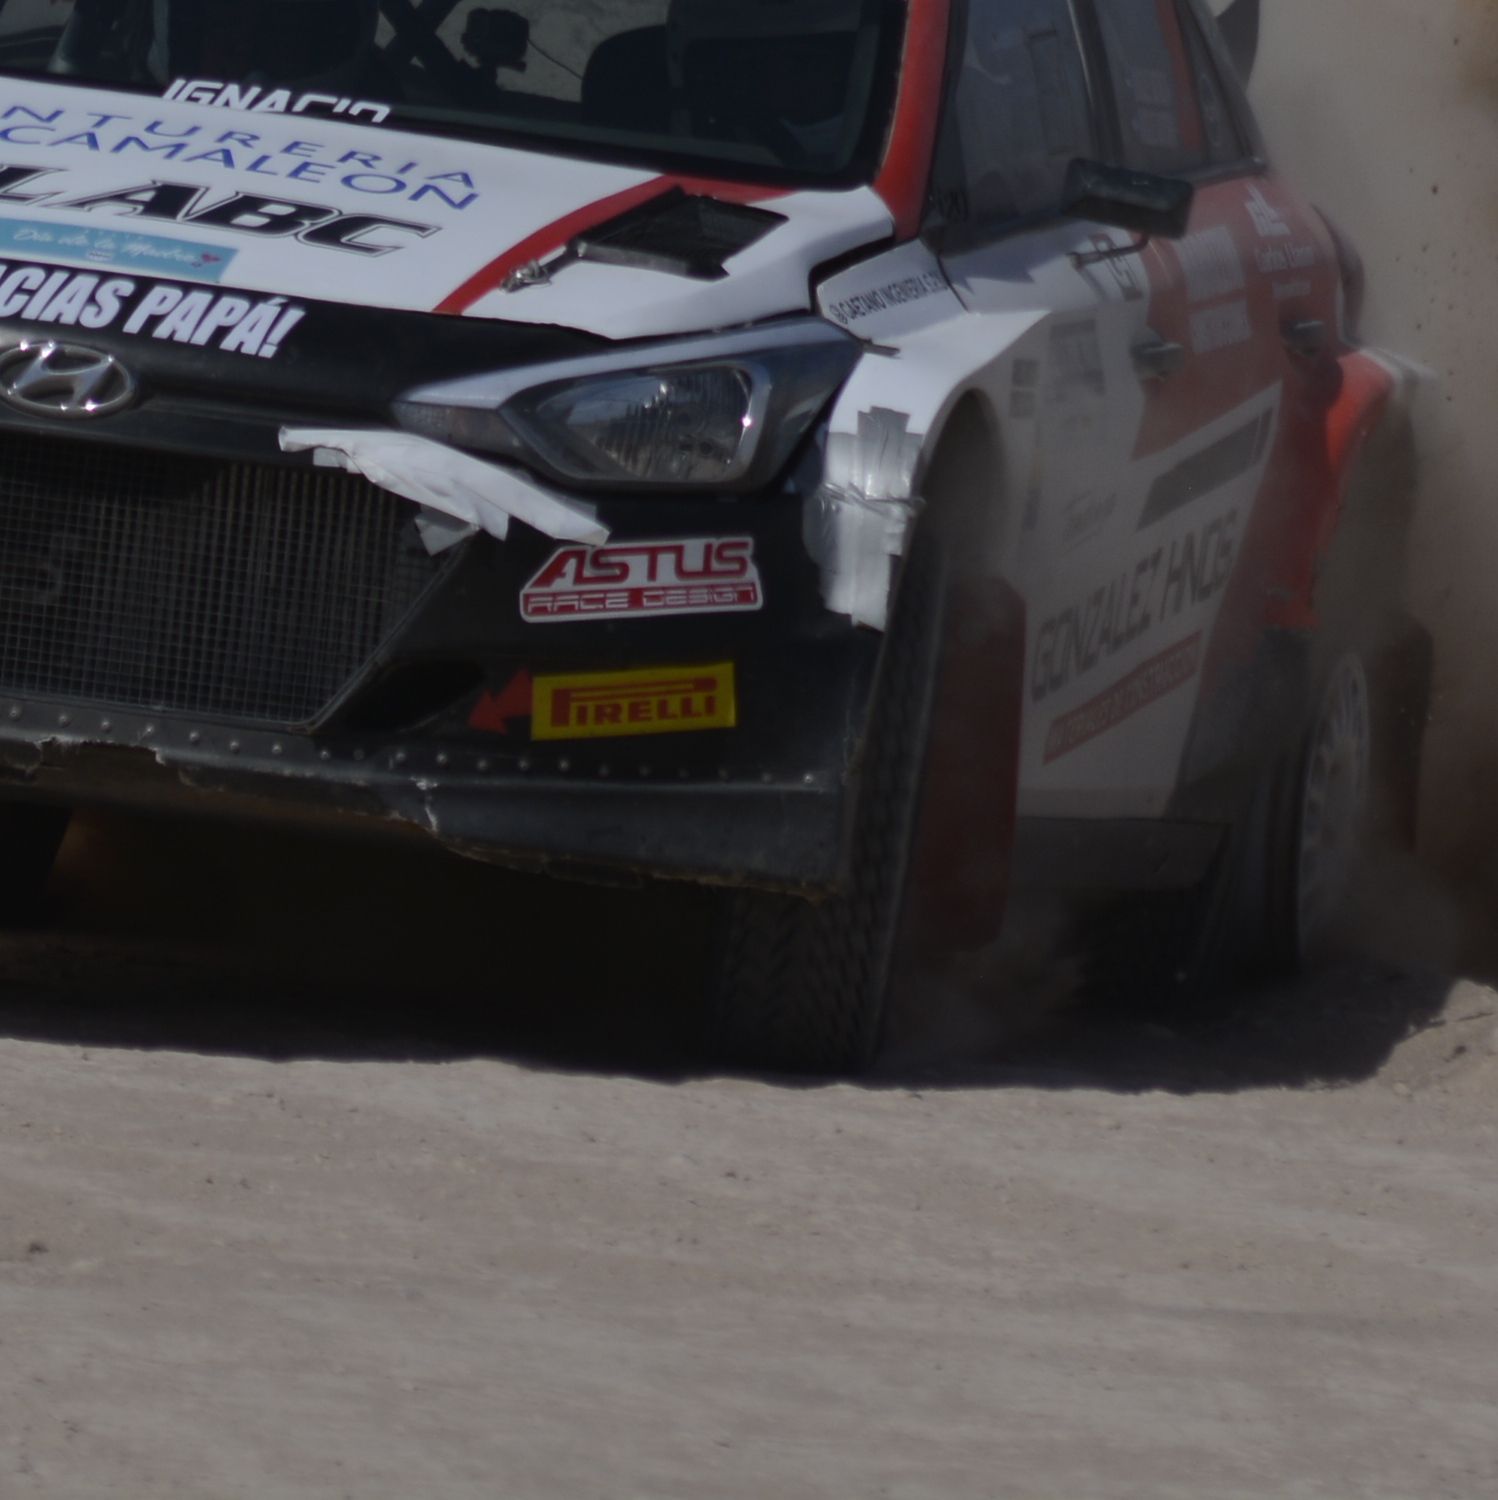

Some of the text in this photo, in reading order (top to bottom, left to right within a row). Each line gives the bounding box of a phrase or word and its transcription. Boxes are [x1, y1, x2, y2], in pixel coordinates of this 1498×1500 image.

[122, 285, 307, 360] PAPÁ!
[528, 541, 750, 589] ASTUS
[527, 584, 756, 613] RACE DESIGN
[1030, 546, 1163, 704] GONZALEZ
[550, 676, 719, 729] PIRELLI
